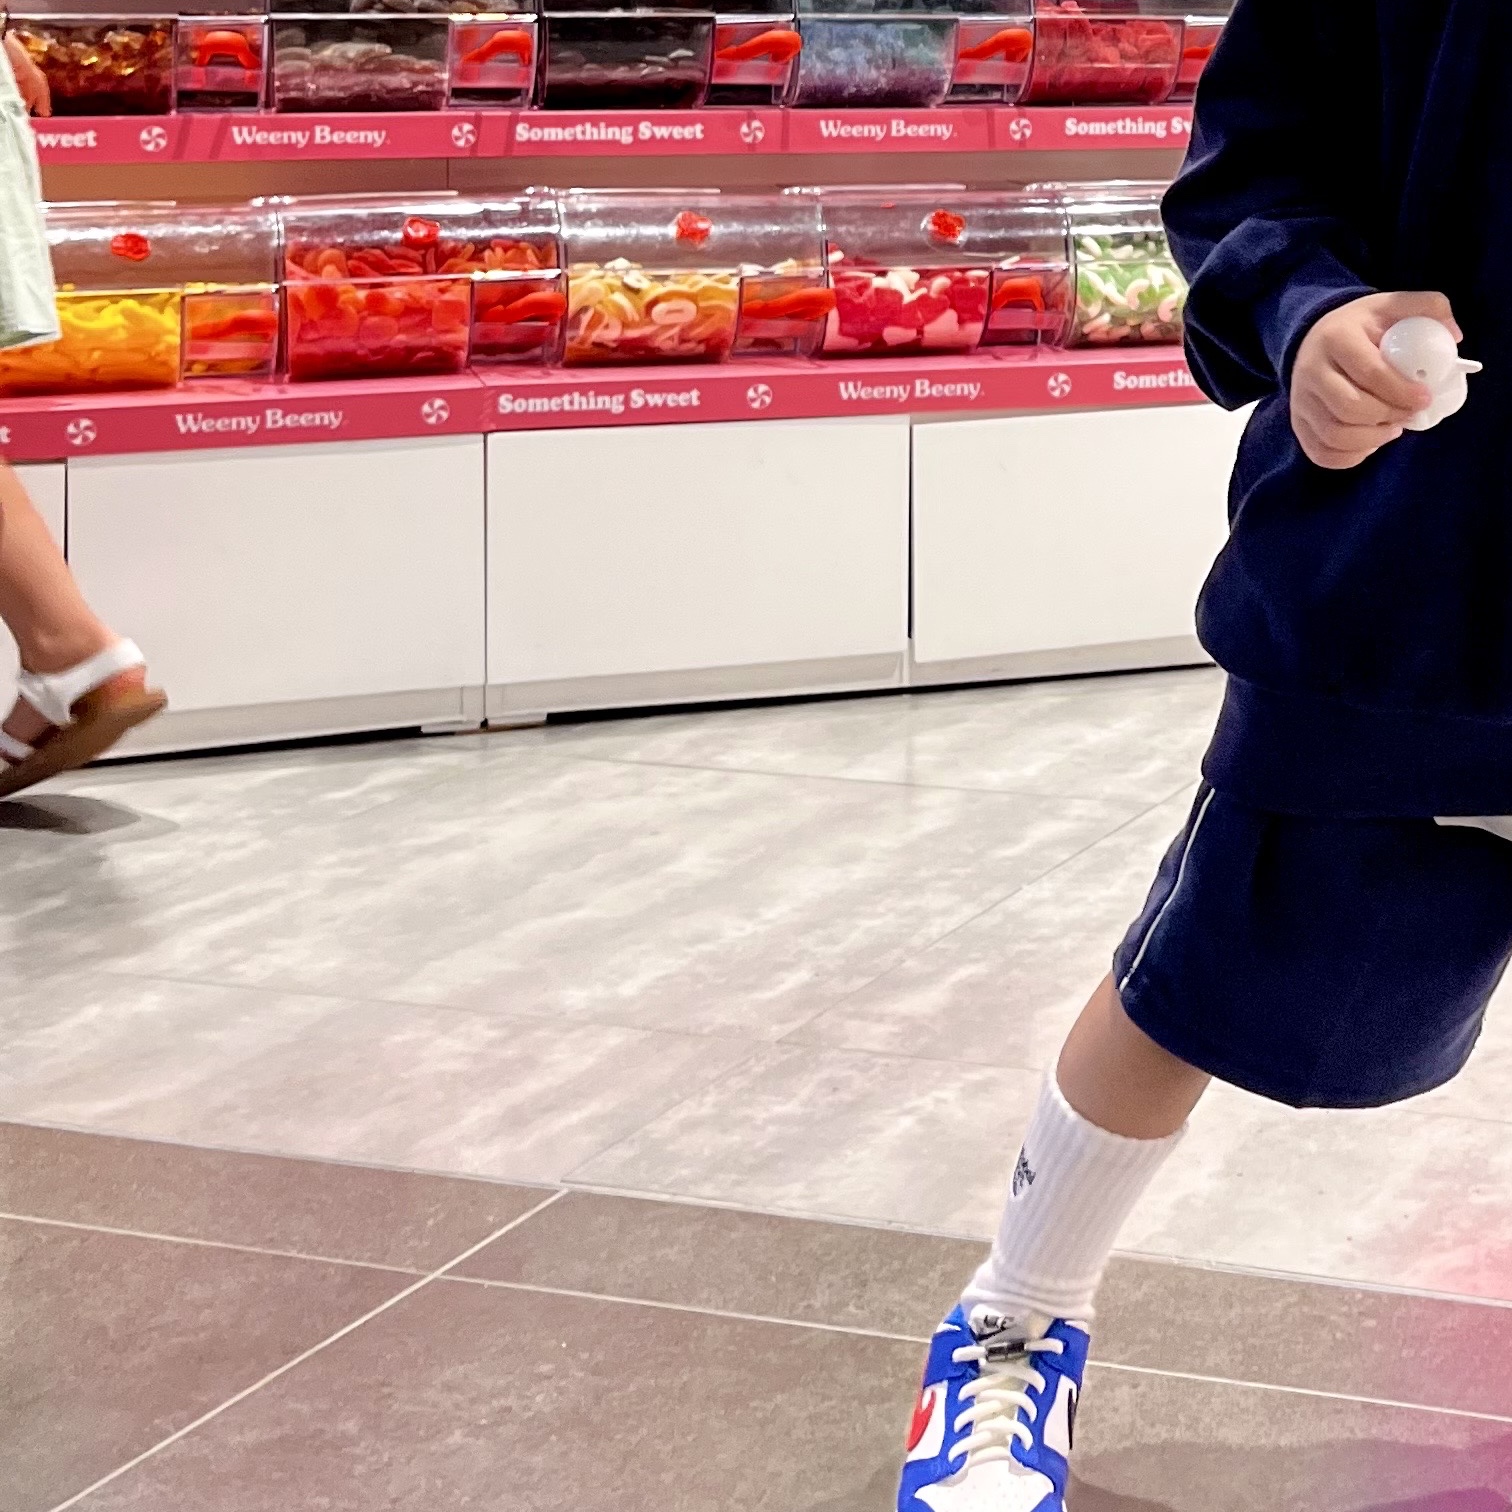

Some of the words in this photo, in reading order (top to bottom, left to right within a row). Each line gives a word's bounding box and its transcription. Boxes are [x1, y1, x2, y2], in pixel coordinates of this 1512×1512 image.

[37, 130, 97, 148] weet
[231, 126, 310, 148] Weeny
[515, 122, 633, 144] Something
[638, 121, 704, 140] Sweet
[820, 120, 887, 141] Weeny
[1065, 117, 1167, 139] Something
[1113, 369, 1198, 390] Someth
[498, 390, 625, 414] Something
[629, 388, 700, 409] Sweet
[839, 381, 911, 402] Weeny
[175, 412, 261, 434] Weeny
